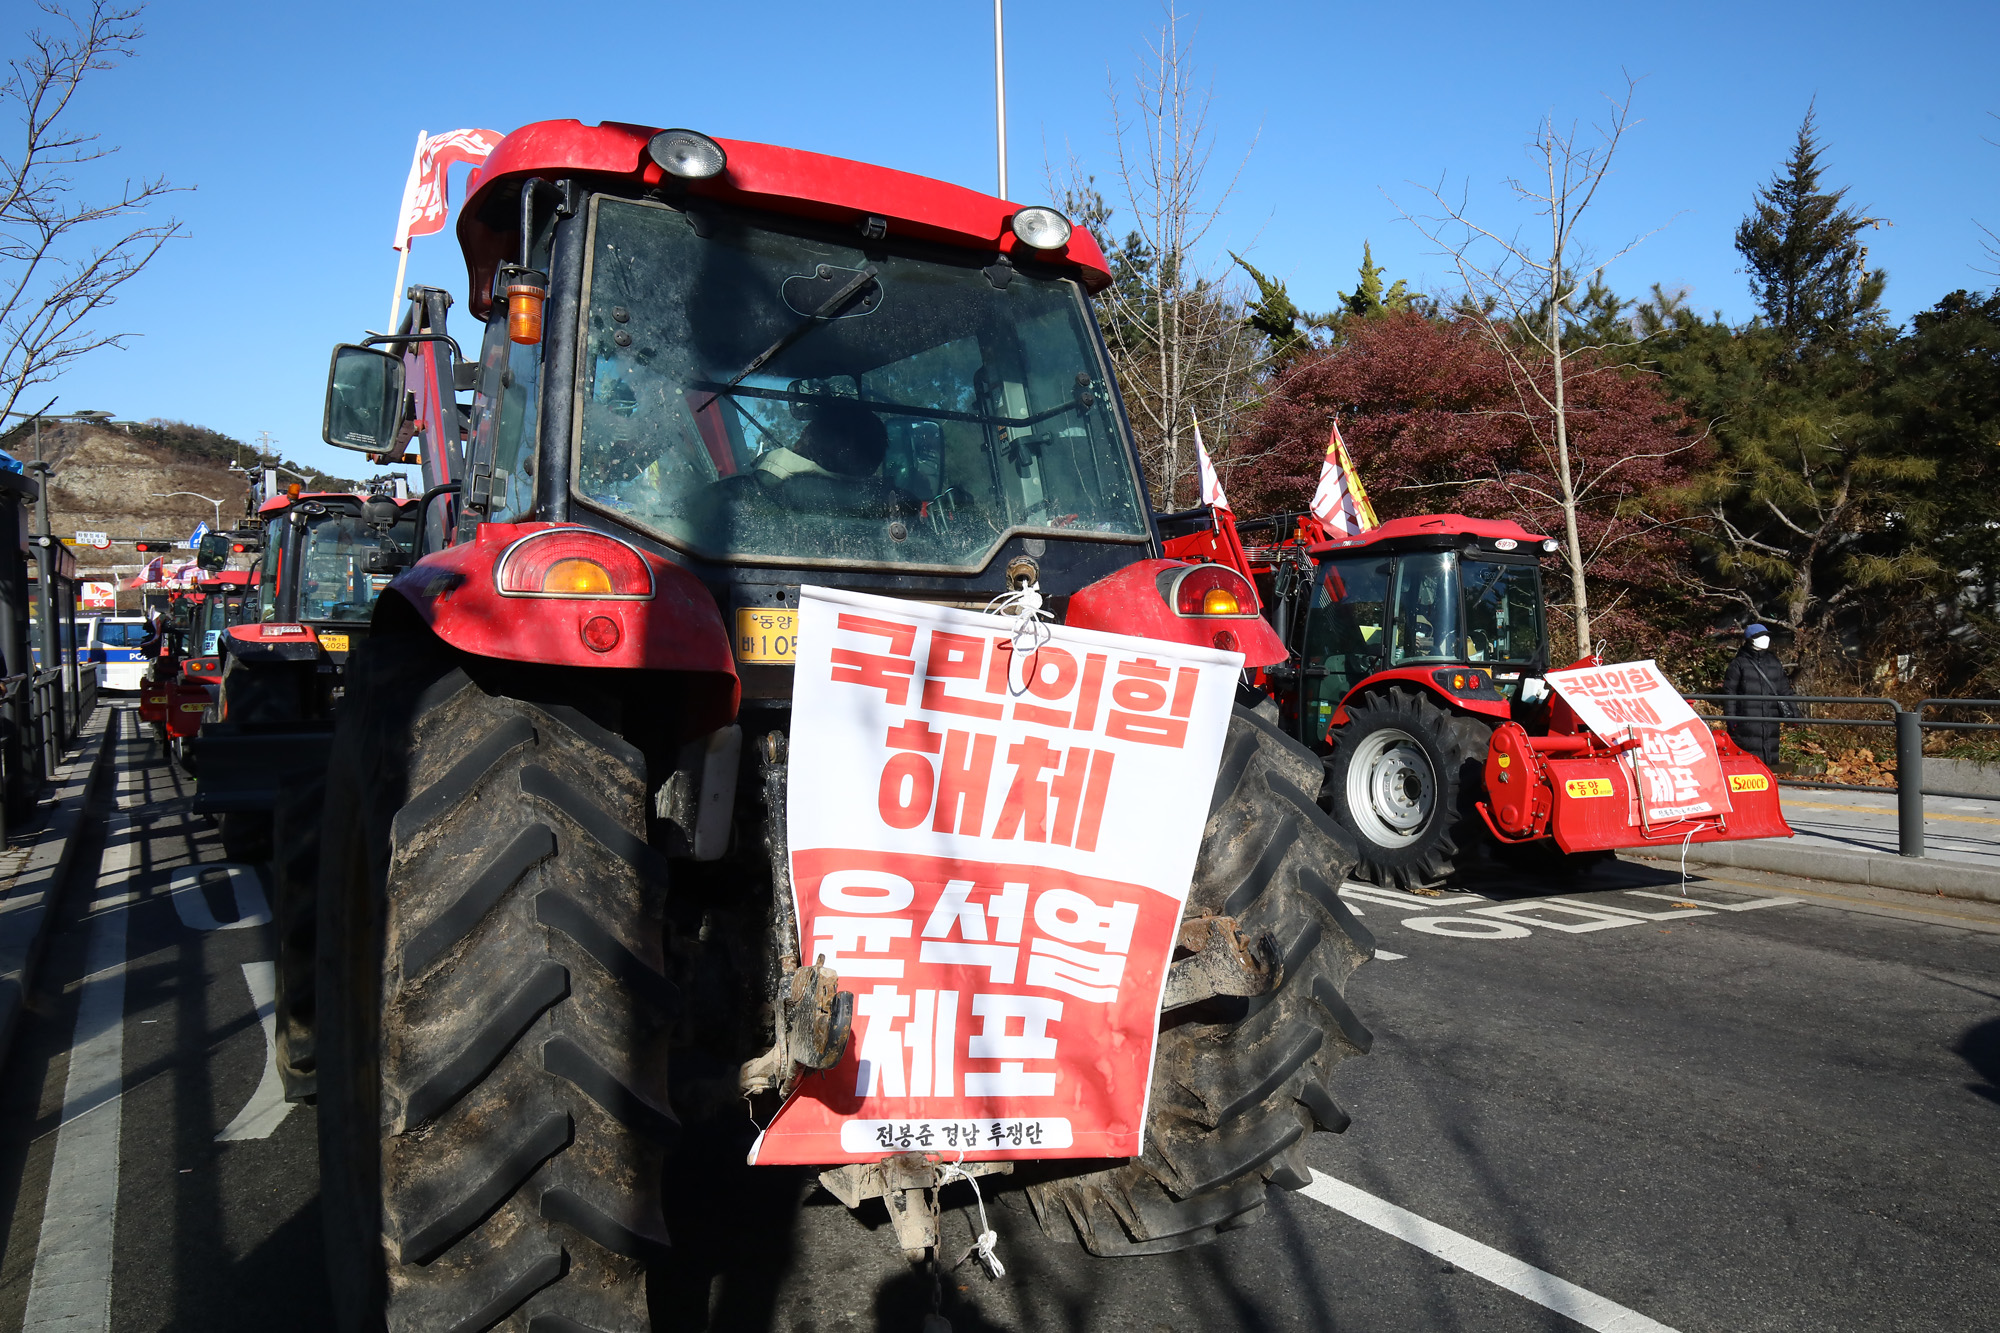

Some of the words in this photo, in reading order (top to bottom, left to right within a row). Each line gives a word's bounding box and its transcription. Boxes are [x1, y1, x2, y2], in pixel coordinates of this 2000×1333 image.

[93, 599, 107, 607] SK
[759, 615, 793, 630] 동양
[830, 612, 1200, 749] 국민의힘
[1558, 667, 1660, 697] 국민의힘
[878, 719, 1116, 852] 해체
[1577, 781, 1599, 796] 동양
[1643, 767, 1702, 803] 체포
[812, 869, 1139, 1003] 윤석열
[855, 985, 1063, 1098] 체포
[875, 1123, 935, 1148] 전봉준
[941, 1123, 980, 1148] 경남
[987, 1122, 1043, 1147] 투쟁단
